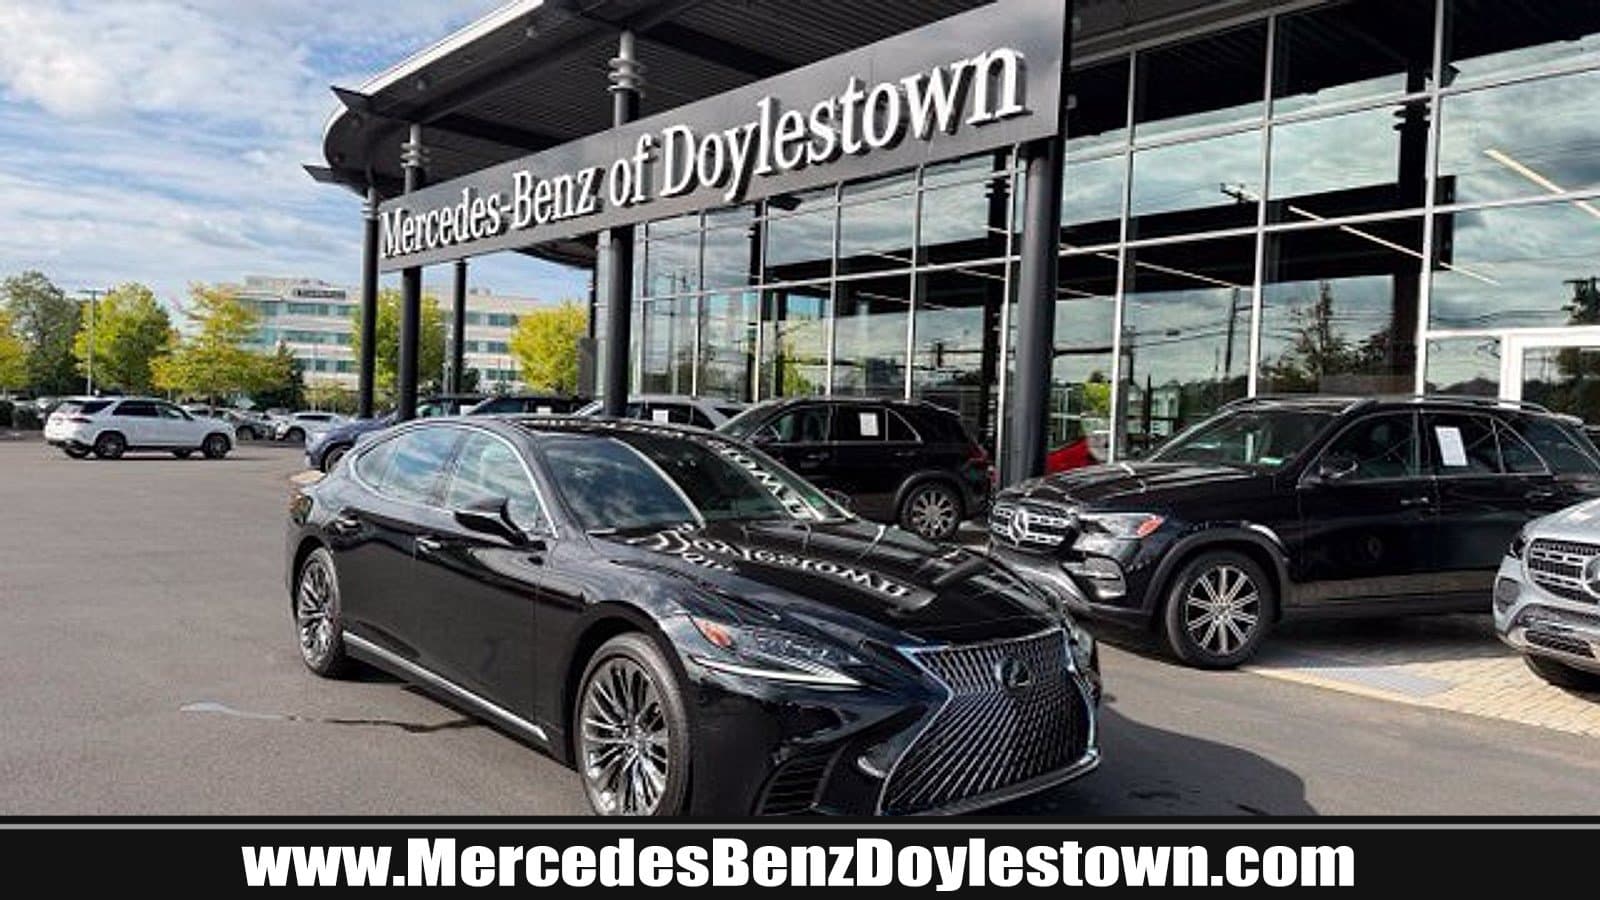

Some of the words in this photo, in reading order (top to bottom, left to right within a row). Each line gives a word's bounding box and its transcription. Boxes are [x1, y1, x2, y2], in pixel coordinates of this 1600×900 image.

[379, 166, 598, 258] Mercedes-Benz
[609, 140, 652, 207] of
[660, 47, 1026, 202] Doylestown
